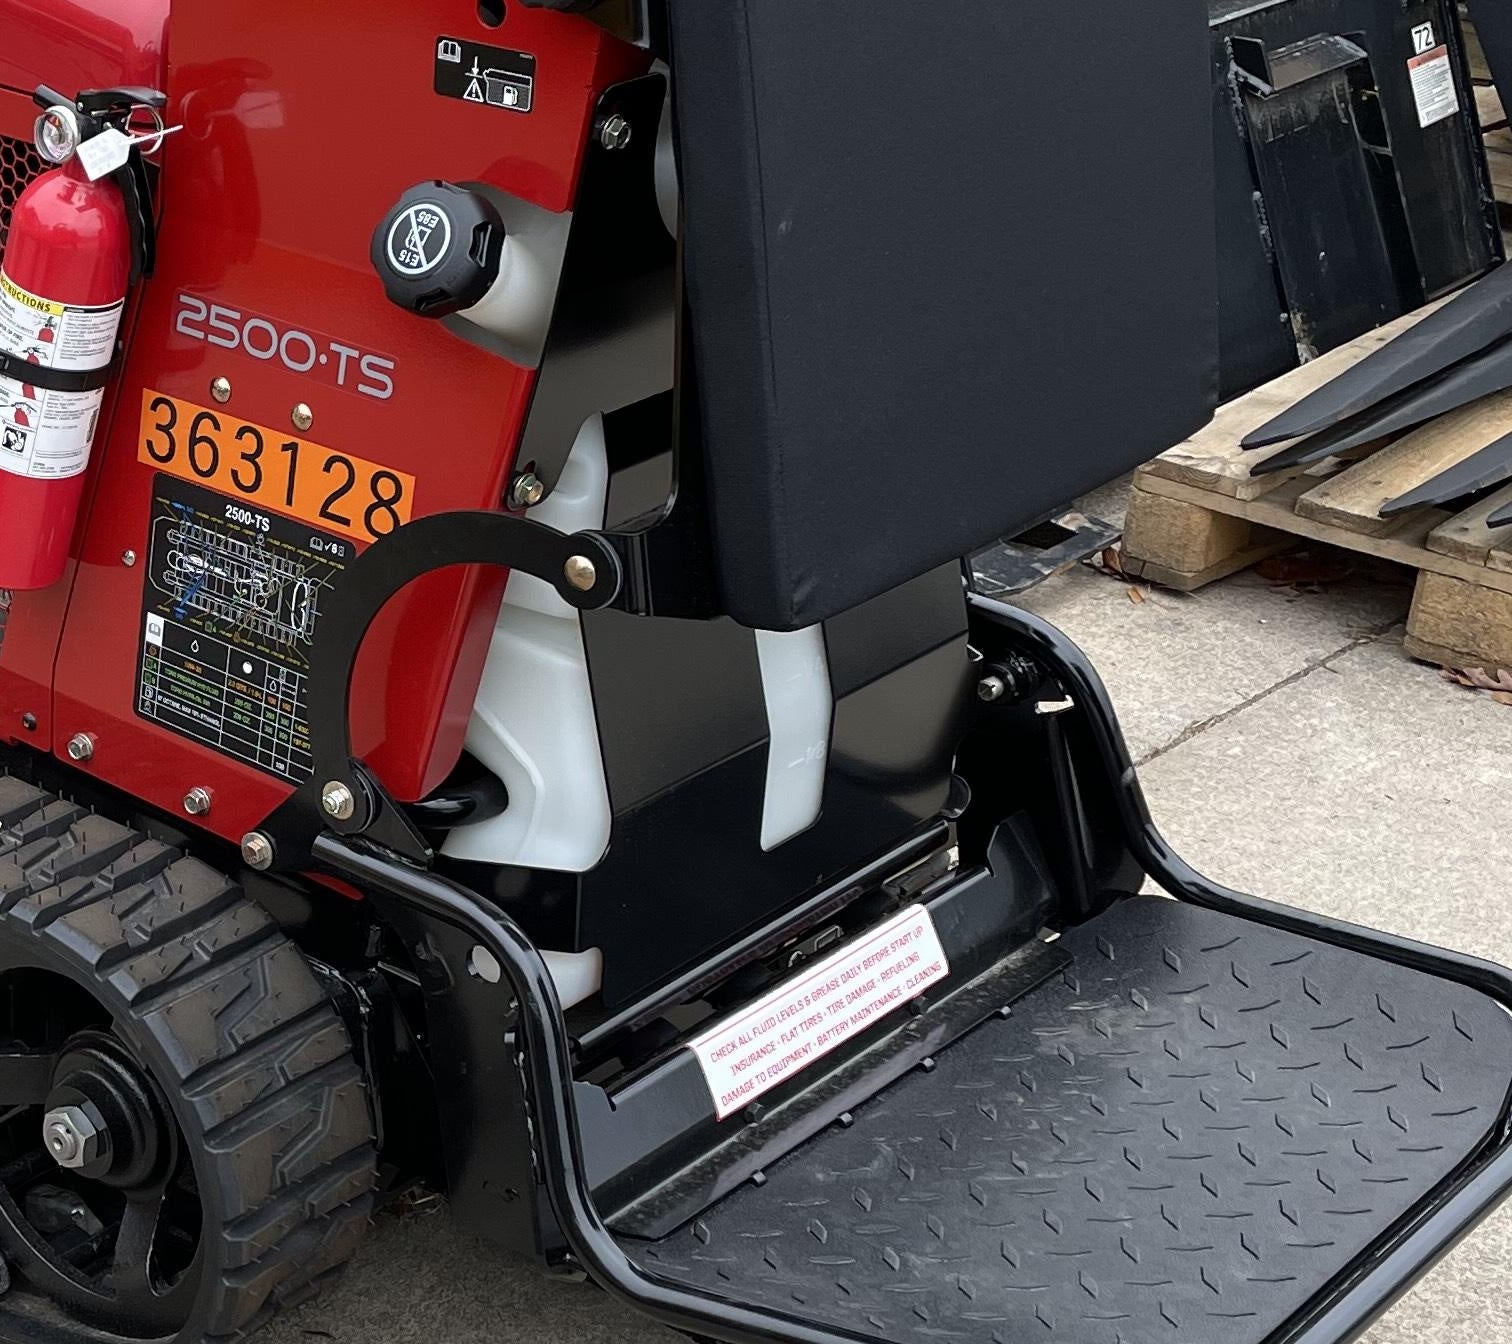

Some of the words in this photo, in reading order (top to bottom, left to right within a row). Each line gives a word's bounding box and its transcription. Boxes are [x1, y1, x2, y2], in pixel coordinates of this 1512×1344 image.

[1414, 27, 1433, 51] 72
[417, 210, 439, 229] E85
[398, 249, 419, 267] E15
[146, 397, 404, 539] 363128
[225, 504, 270, 532] 2500-TS
[710, 1039, 738, 1063] CHECK
[738, 1031, 753, 1047] ALL
[752, 1016, 777, 1039] FLUID
[776, 999, 805, 1024] LEVELS
[811, 977, 840, 1003] GREASE
[840, 964, 862, 984] DAILY
[862, 946, 890, 971] BEFORE
[890, 932, 912, 953] START
[913, 925, 924, 939] UP
[729, 1040, 777, 1076] INSURANCE
[780, 1027, 799, 1045] FLAT
[798, 1012, 823, 1035] TIRES
[826, 999, 846, 1016] TIRE
[845, 978, 877, 1005] DAMAGE
[879, 951, 920, 982] REFUELING
[720, 1079, 755, 1106] DAMAGE
[755, 1071, 767, 1086] TO
[767, 1042, 813, 1078] EQUIPMENT
[816, 1019, 849, 1047] BATTERY
[850, 984, 903, 1025] MAINTENANCE
[906, 960, 942, 989] CLEANING
